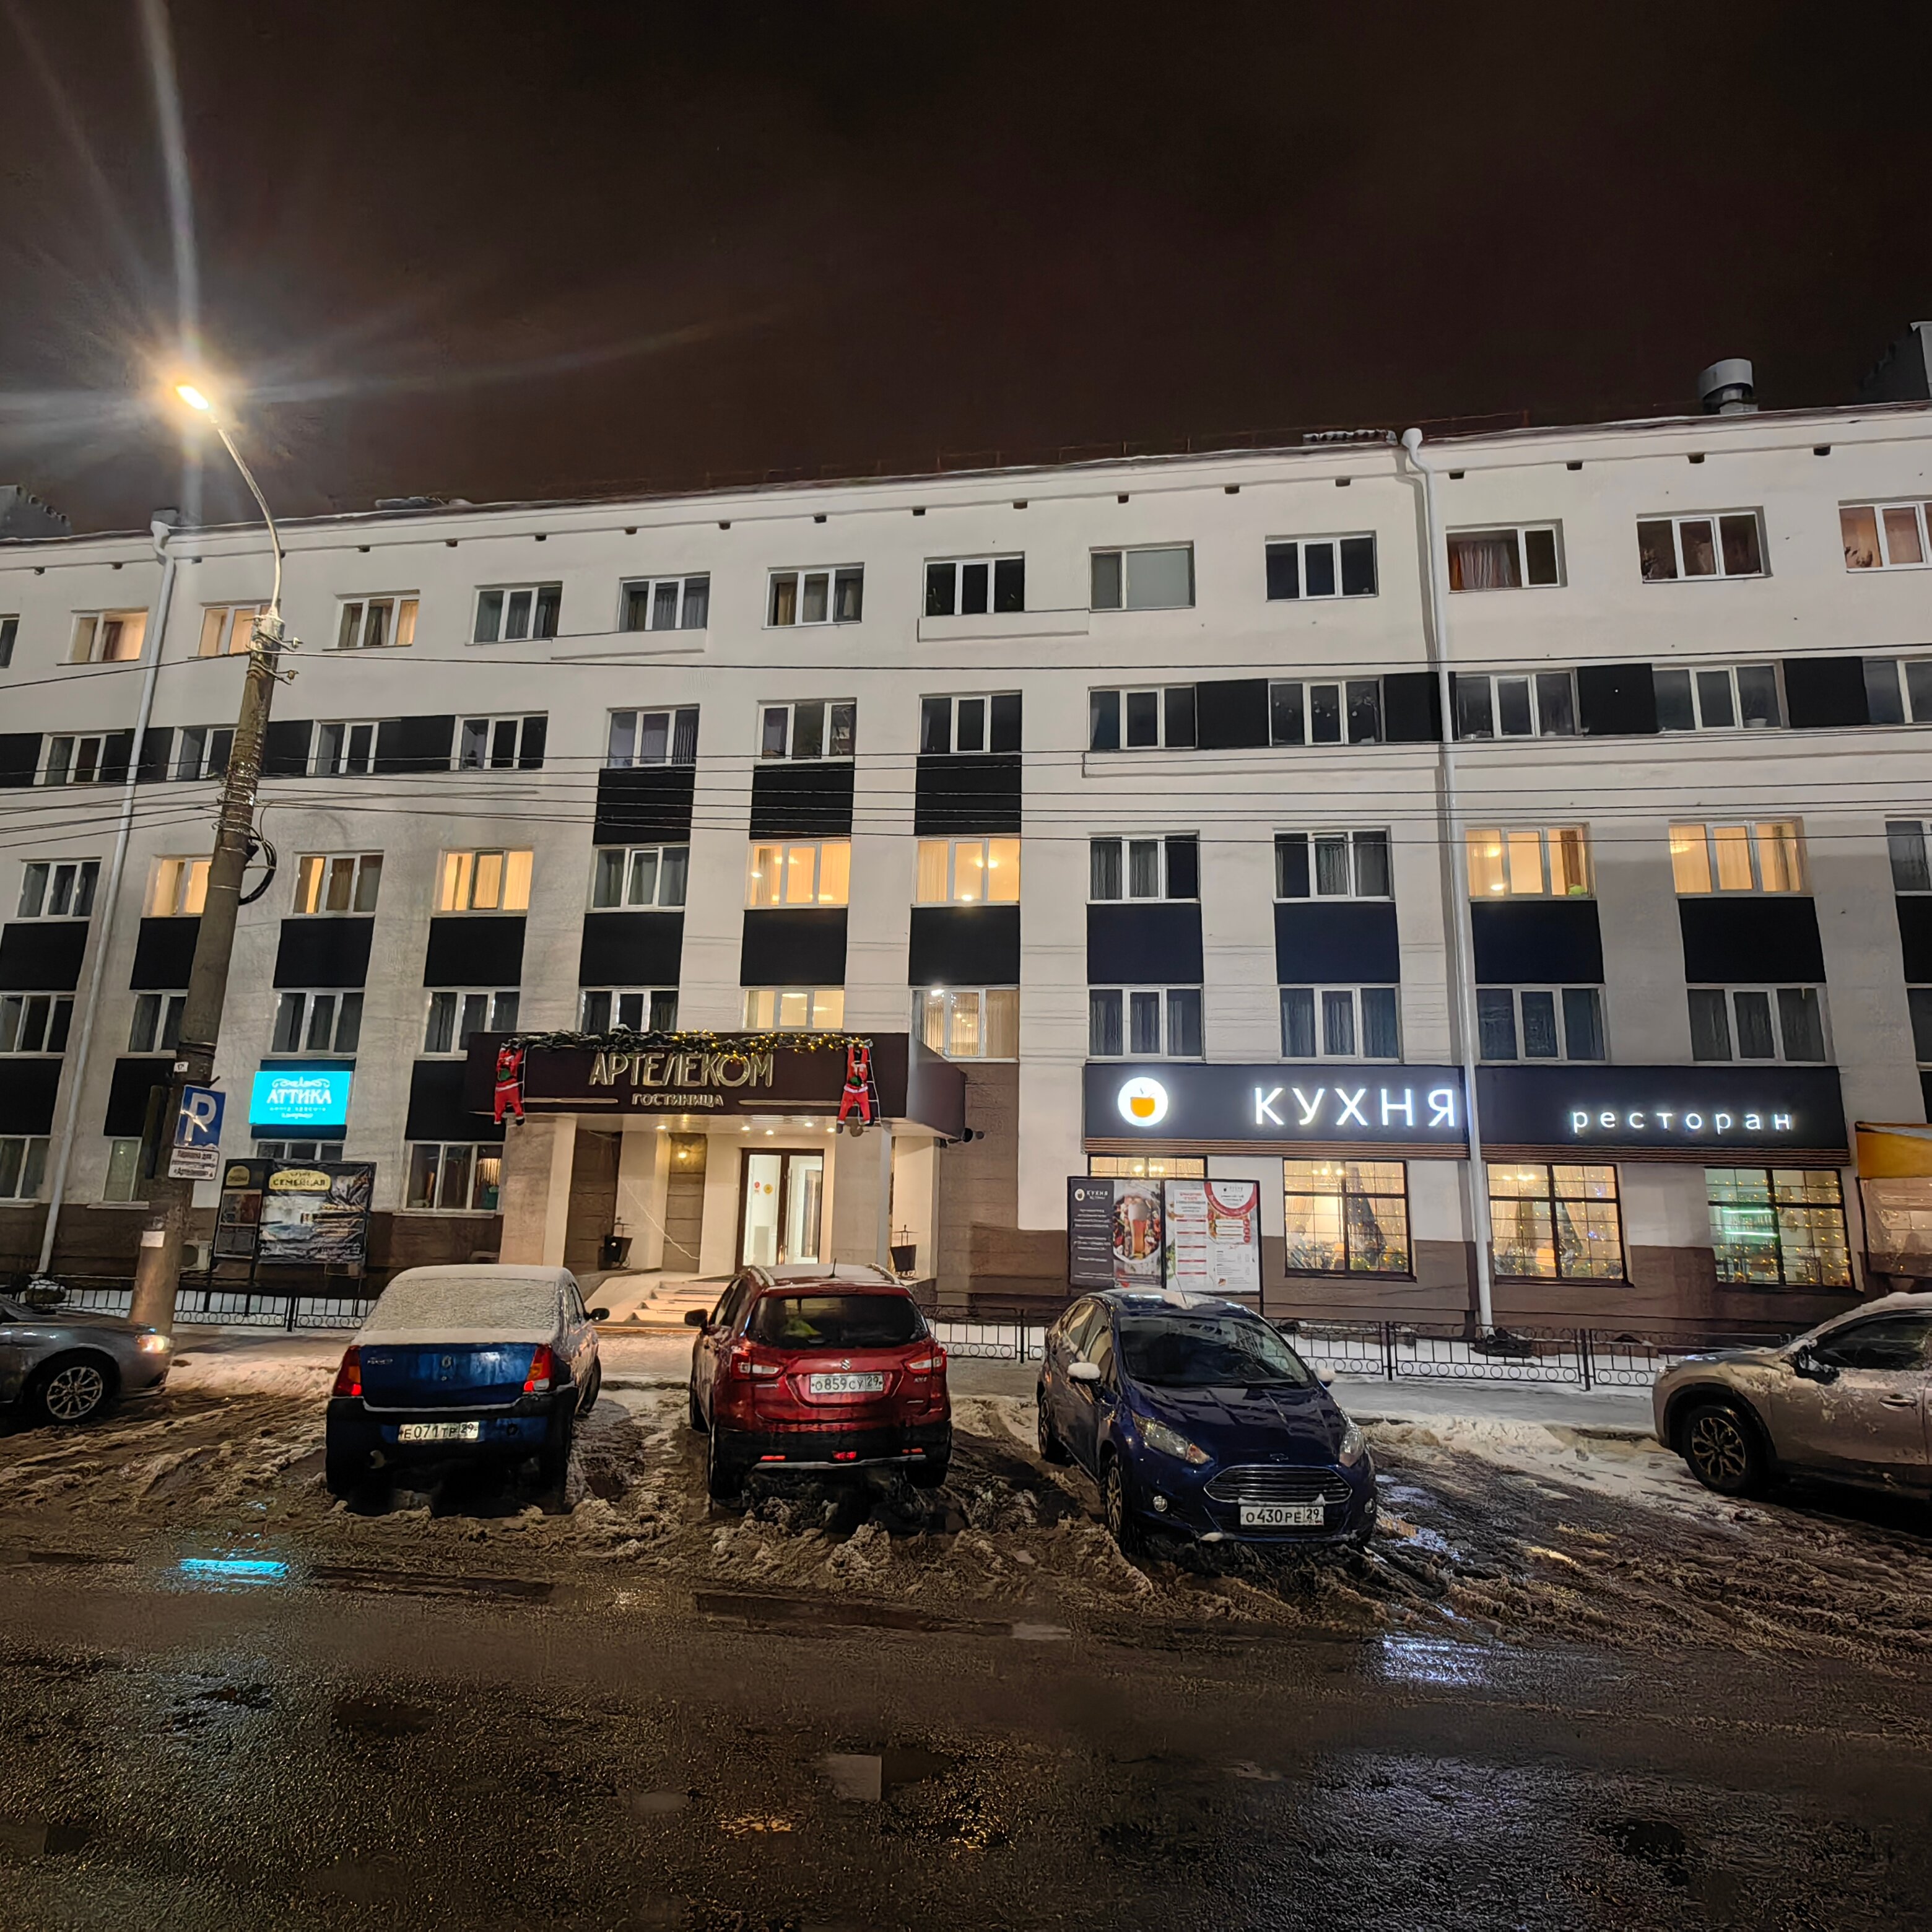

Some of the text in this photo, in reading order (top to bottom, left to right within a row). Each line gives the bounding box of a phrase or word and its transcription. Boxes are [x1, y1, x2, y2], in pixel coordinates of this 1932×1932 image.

[589, 1052, 773, 1087] АРТЕЛЕКОМ
[266, 1089, 332, 1104] АТТИКА
[632, 1093, 724, 1107] ГОСТИНИЦА
[1255, 1087, 1456, 1126] КУХНЯ
[1572, 1110, 1791, 1135] ресторан
